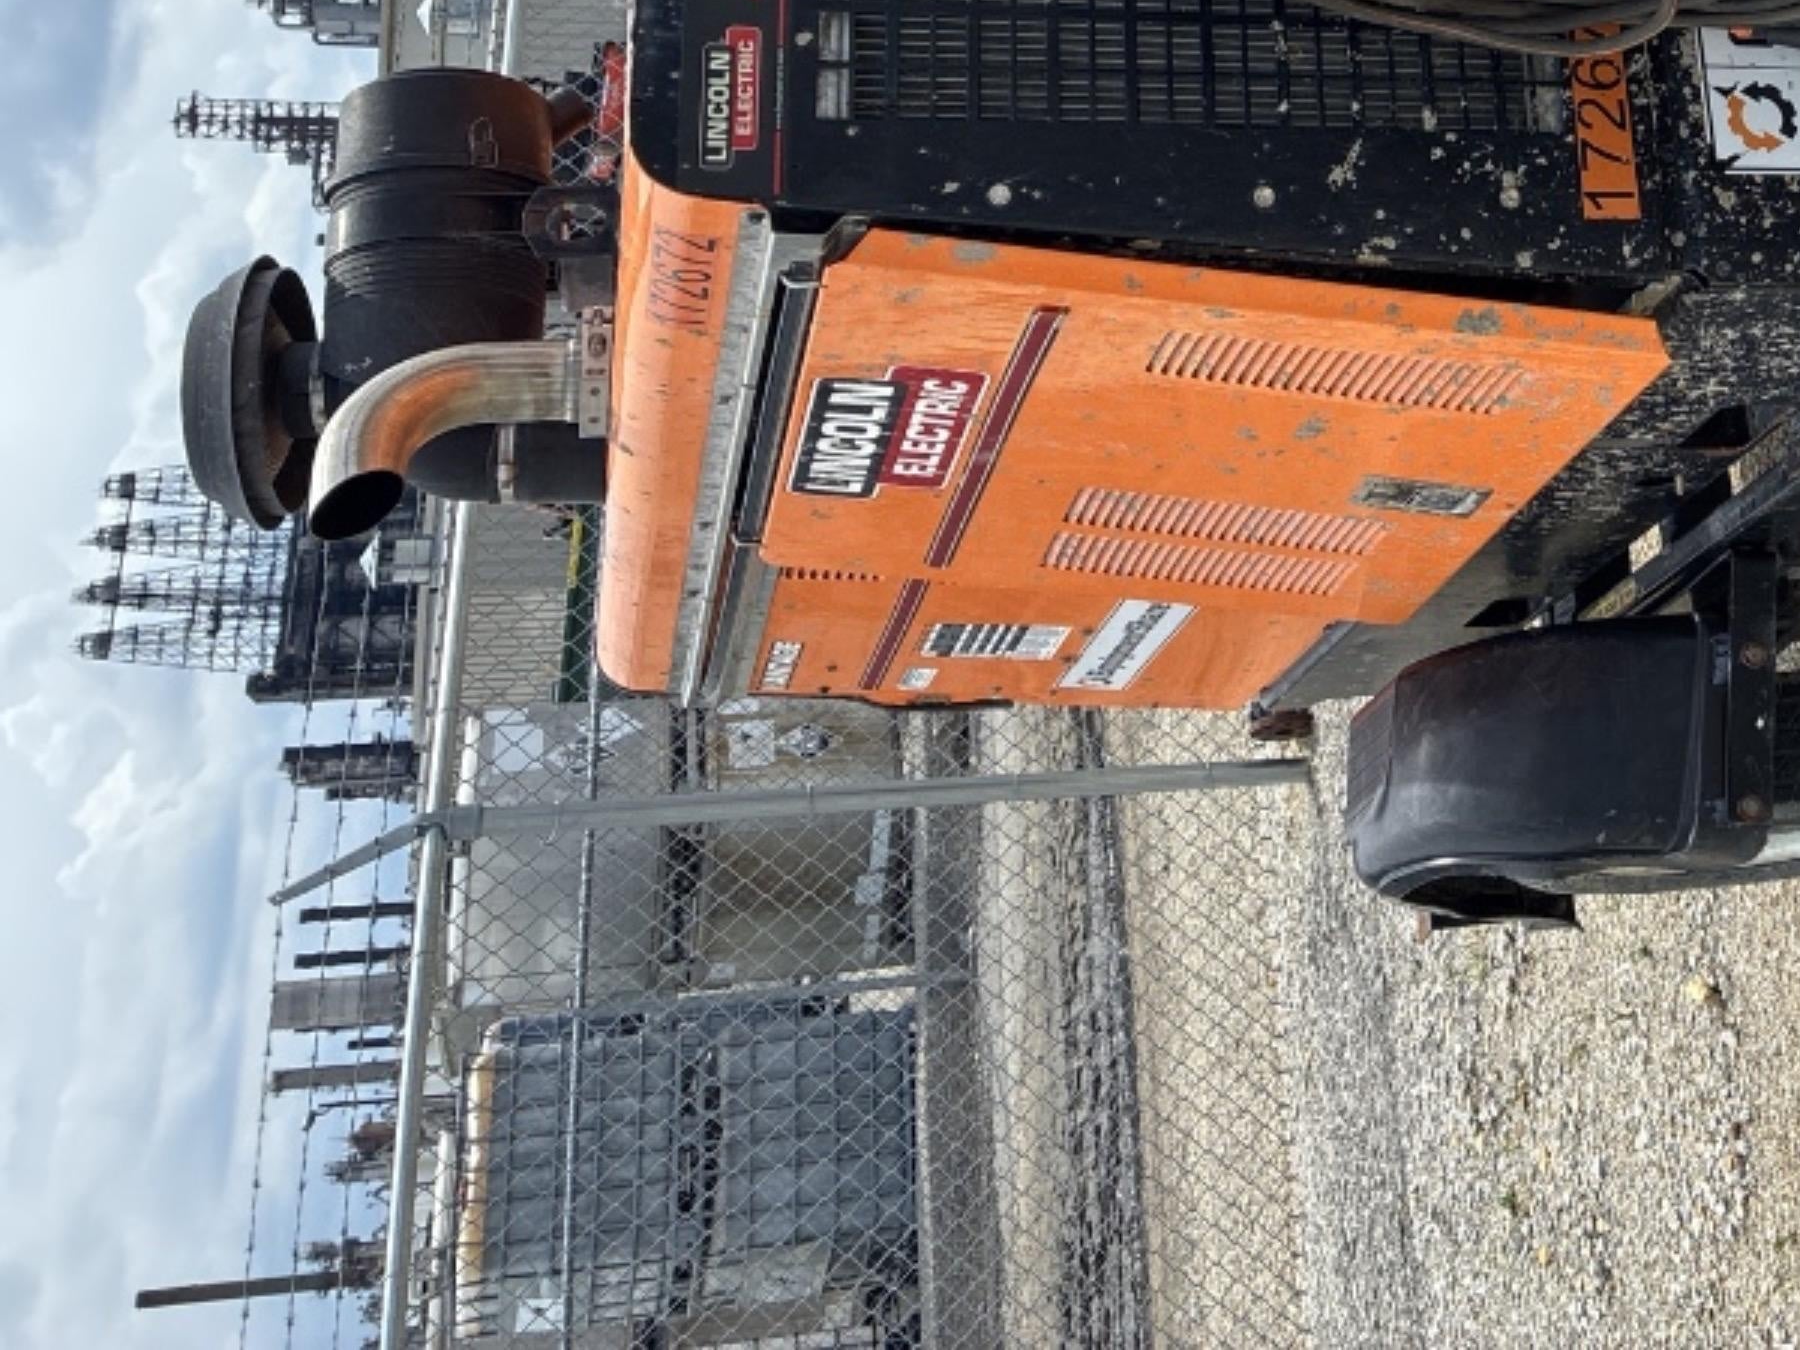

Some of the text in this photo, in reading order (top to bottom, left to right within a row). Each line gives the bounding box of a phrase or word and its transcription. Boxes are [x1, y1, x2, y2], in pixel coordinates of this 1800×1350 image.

[704, 51, 730, 163] LINCOLN
[734, 39, 754, 137] ELECTRIC
[1573, 23, 1636, 211] 1726
[805, 382, 895, 493] LINCOLN
[892, 379, 971, 477] ELECTRIC
